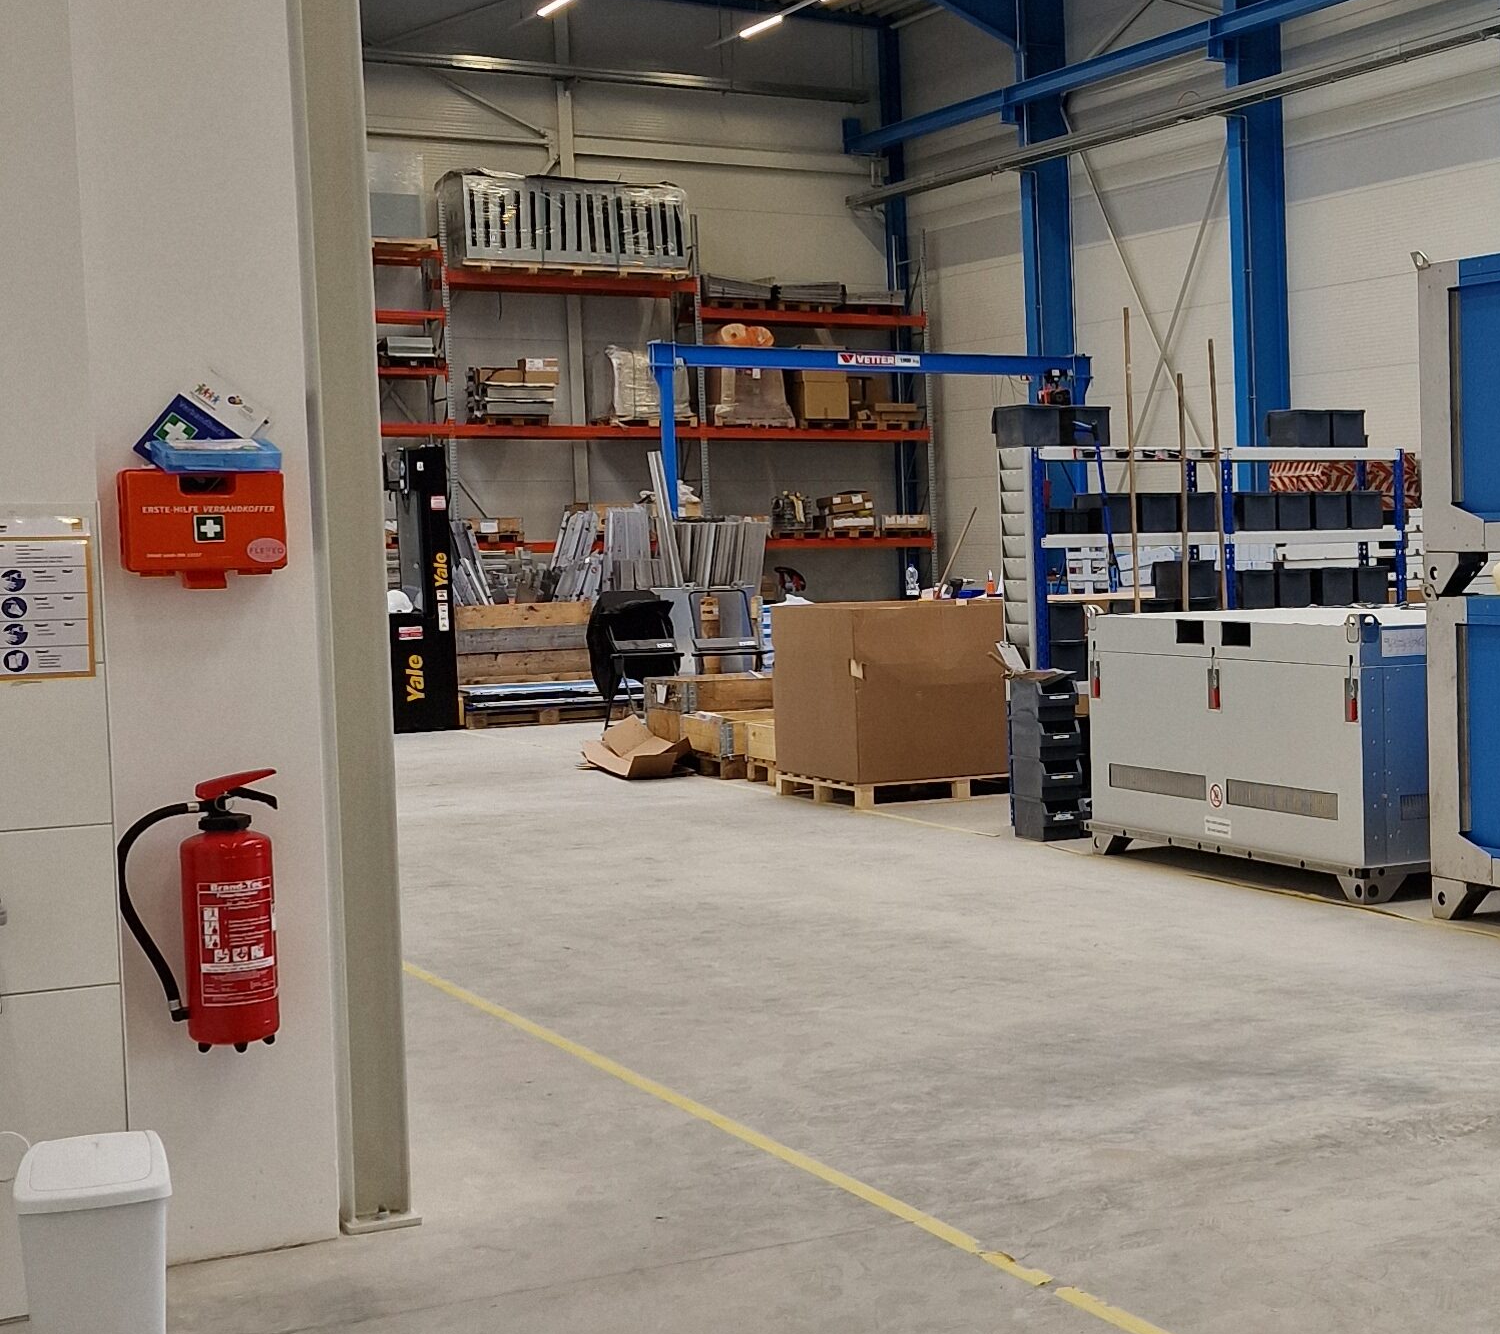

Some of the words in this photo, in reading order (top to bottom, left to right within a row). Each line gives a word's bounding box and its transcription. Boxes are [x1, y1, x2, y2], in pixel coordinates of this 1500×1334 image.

[856, 354, 895, 365] VETTER
[141, 505, 199, 514] ERSTE-HILFE
[202, 504, 276, 514] VERBANDKOFFER
[433, 552, 448, 587] Yale
[405, 654, 426, 702] Yale
